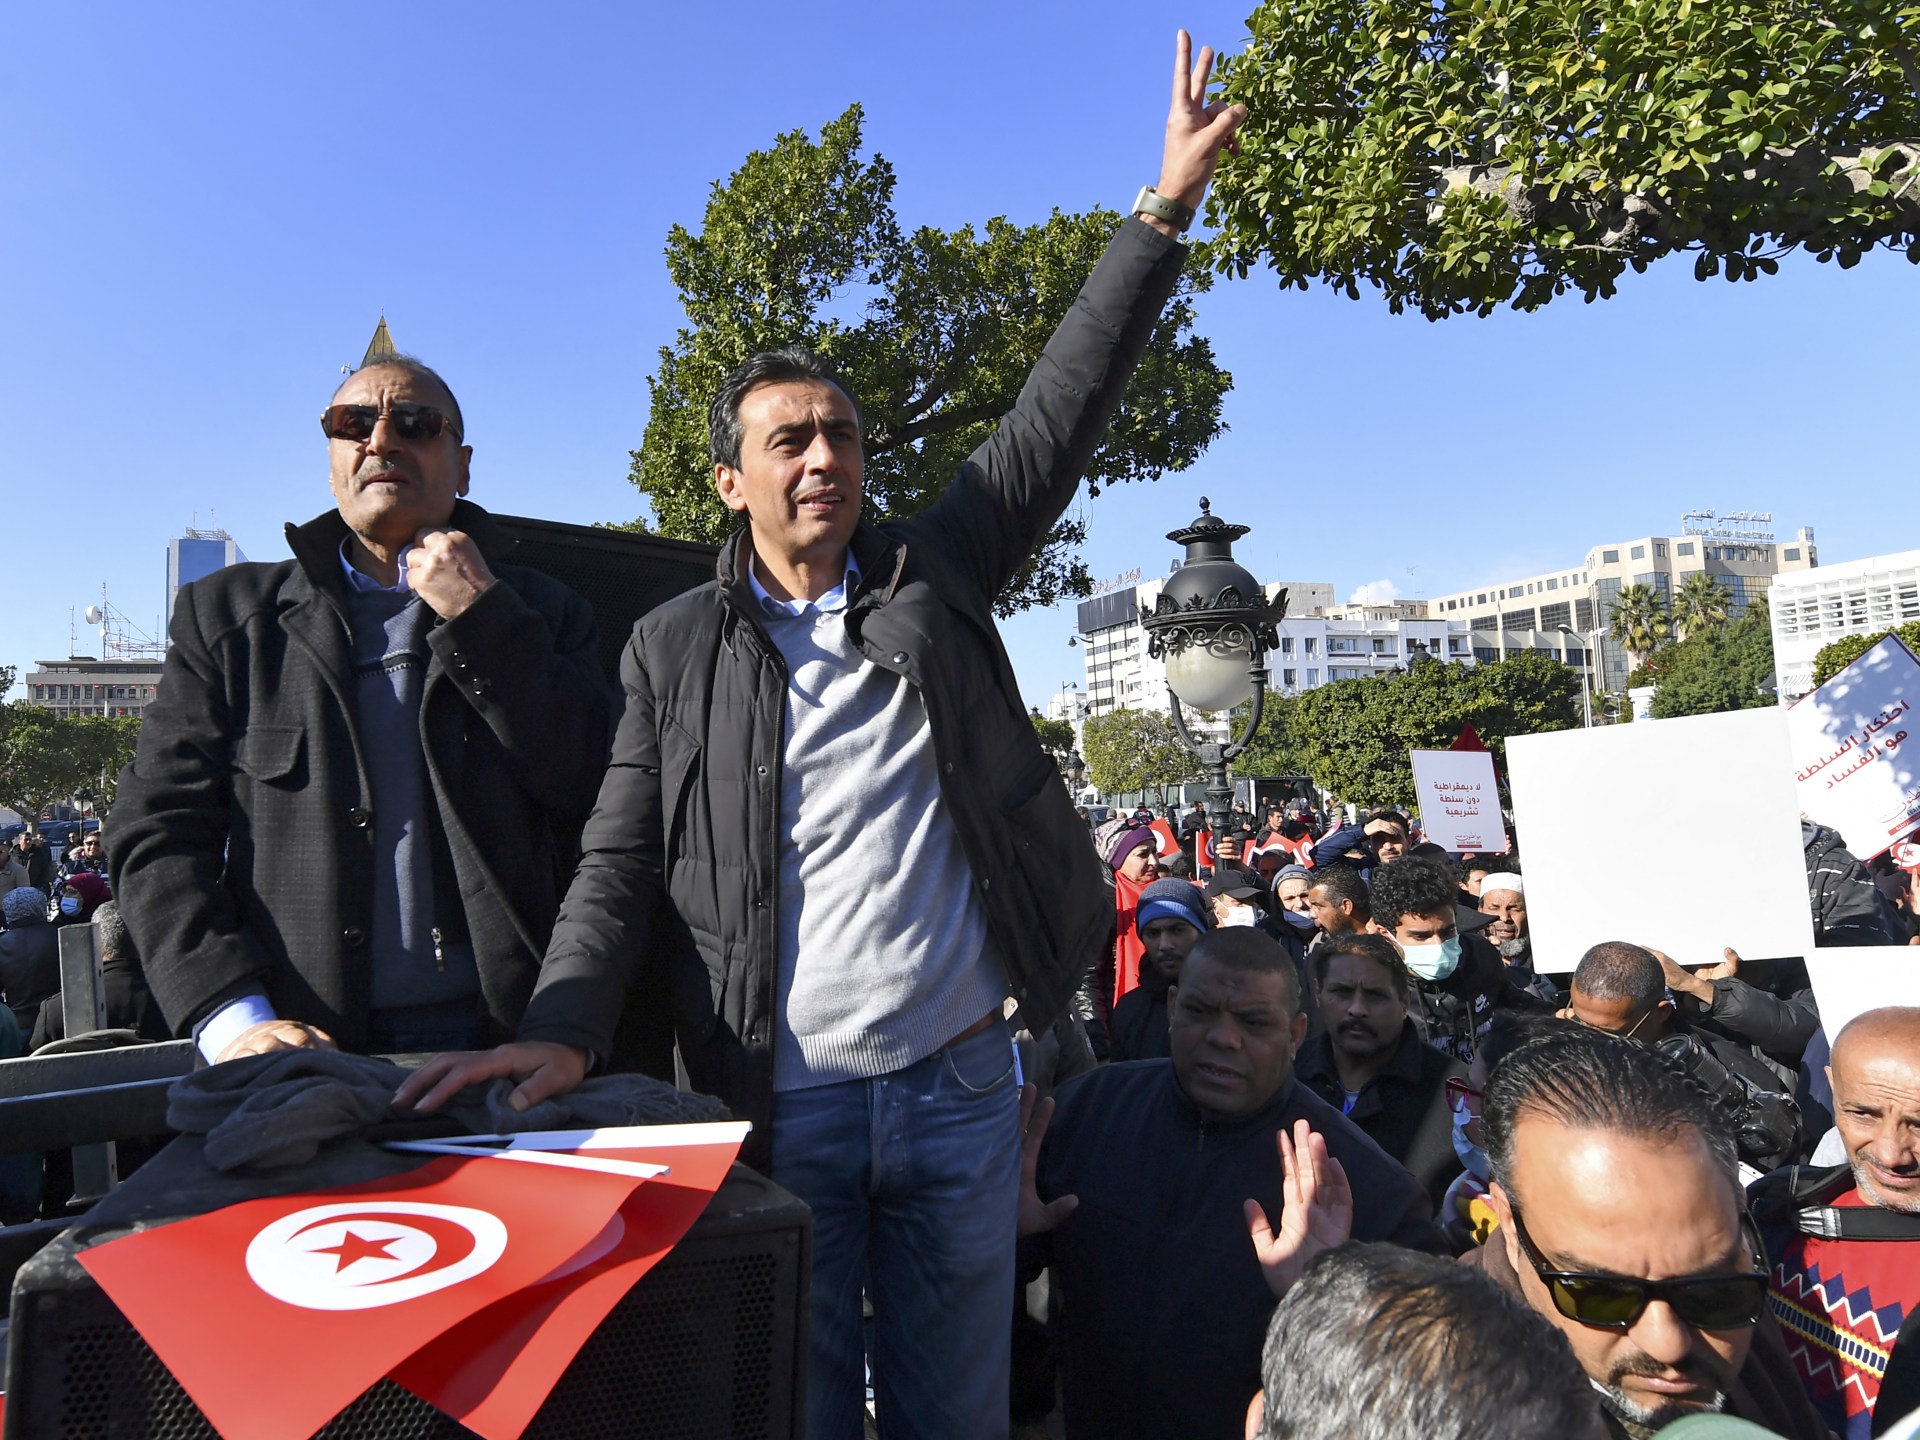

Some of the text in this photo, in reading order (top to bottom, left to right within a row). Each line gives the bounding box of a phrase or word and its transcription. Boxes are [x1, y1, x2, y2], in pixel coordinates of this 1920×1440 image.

[1794, 699, 1910, 782] احتكار السلطة
[1827, 730, 1908, 789] هو الفساد
[1433, 781, 1481, 792] لا ديمقراطية
[1439, 794, 1480, 805] دون سلطة
[1445, 806, 1479, 817] تشريعية
